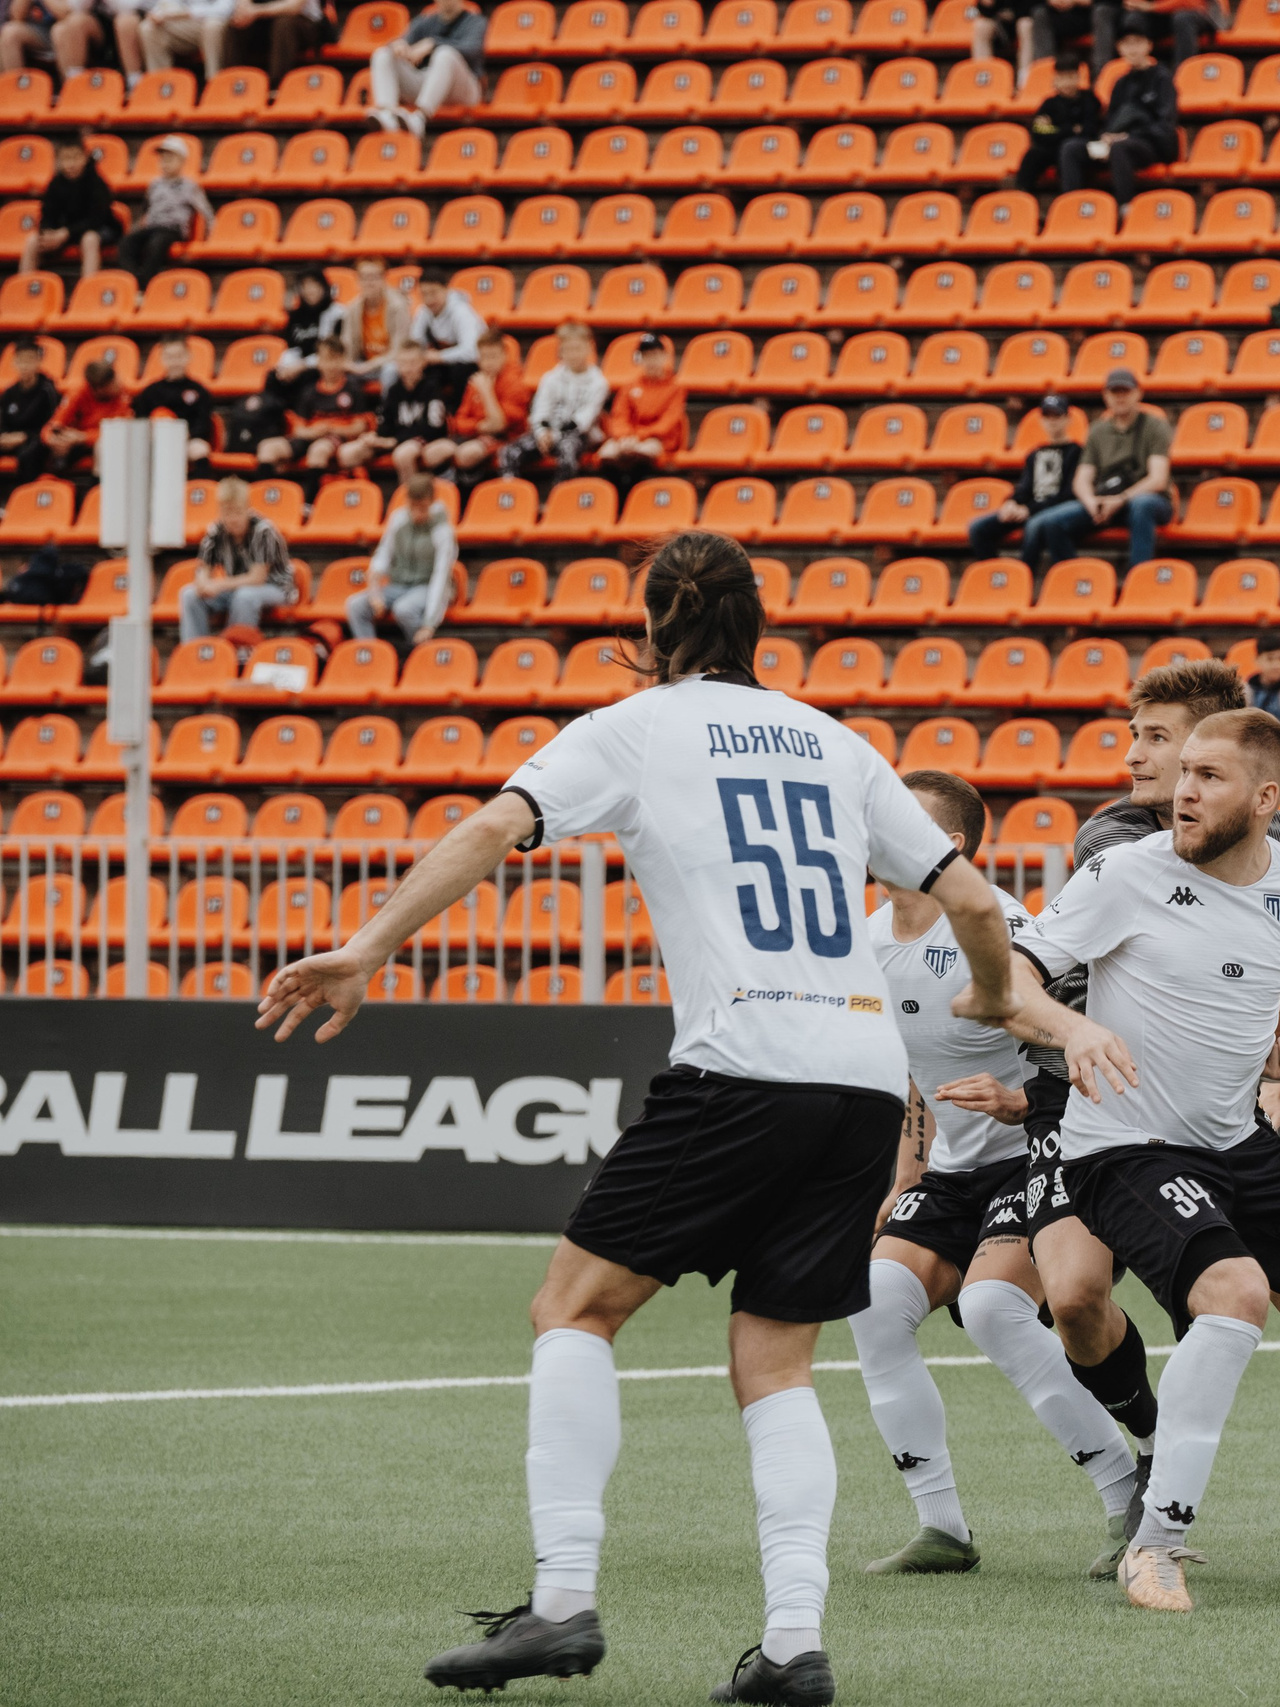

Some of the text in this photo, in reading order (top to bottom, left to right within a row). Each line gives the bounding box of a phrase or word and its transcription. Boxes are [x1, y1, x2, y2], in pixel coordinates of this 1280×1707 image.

[707, 723, 823, 760] ДЬЯКОВ
[716, 777, 853, 958] 55
[1159, 1176, 1215, 1219] 34
